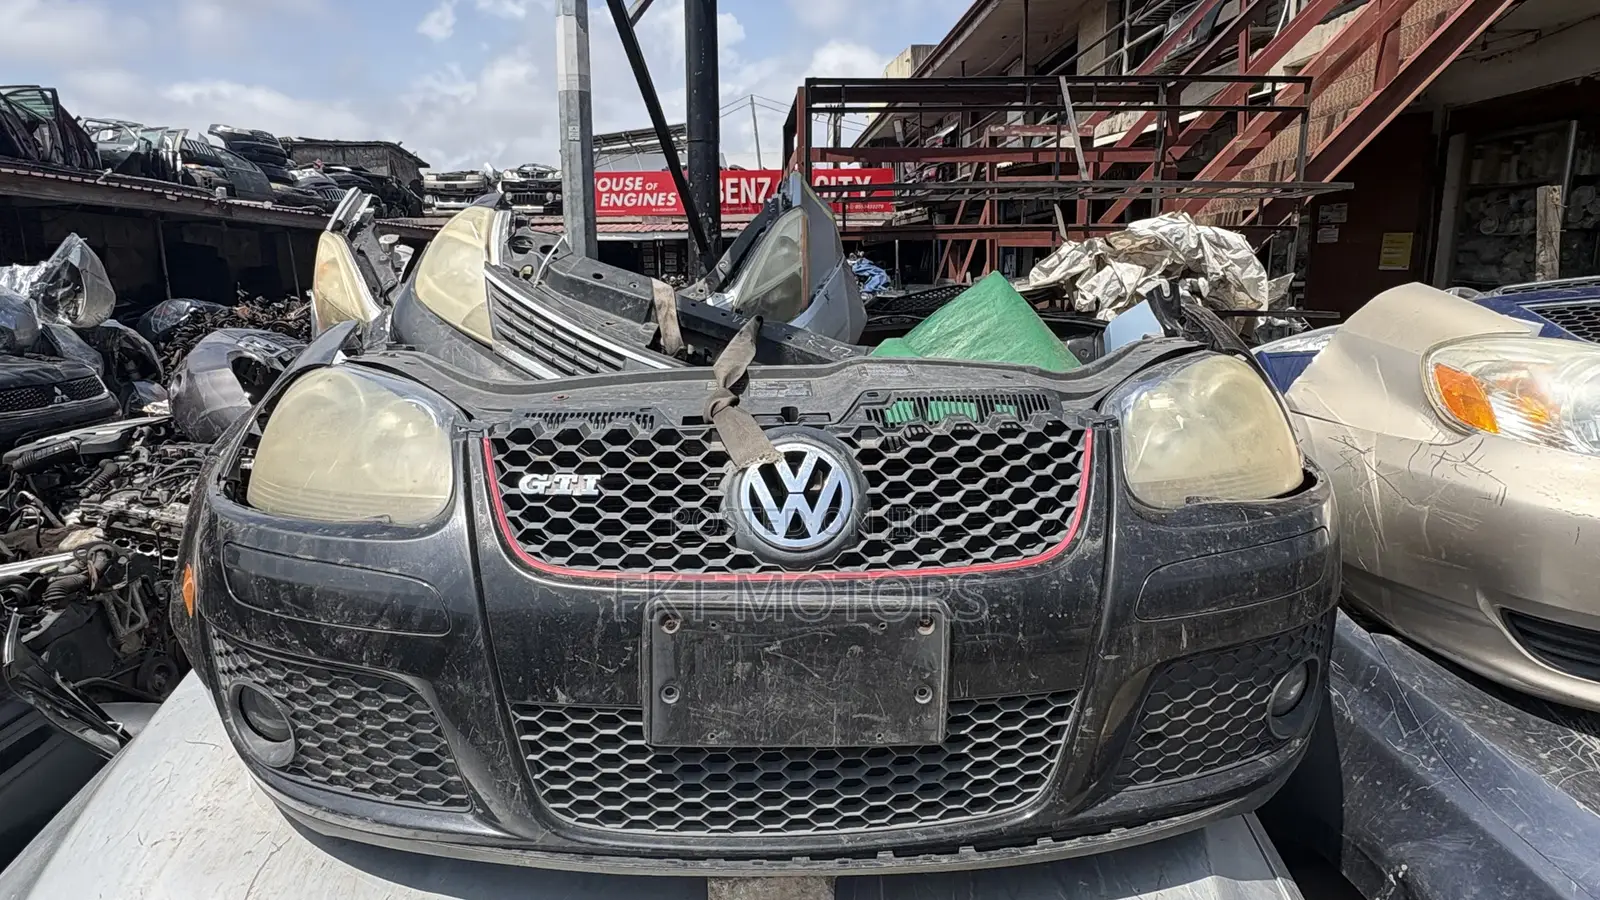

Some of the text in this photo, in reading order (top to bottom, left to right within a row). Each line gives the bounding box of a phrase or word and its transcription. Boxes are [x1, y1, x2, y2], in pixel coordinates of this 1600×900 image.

[594, 177, 658, 192] OUSE OF
[600, 192, 677, 207] ENGINES
[518, 473, 602, 496] GTI
